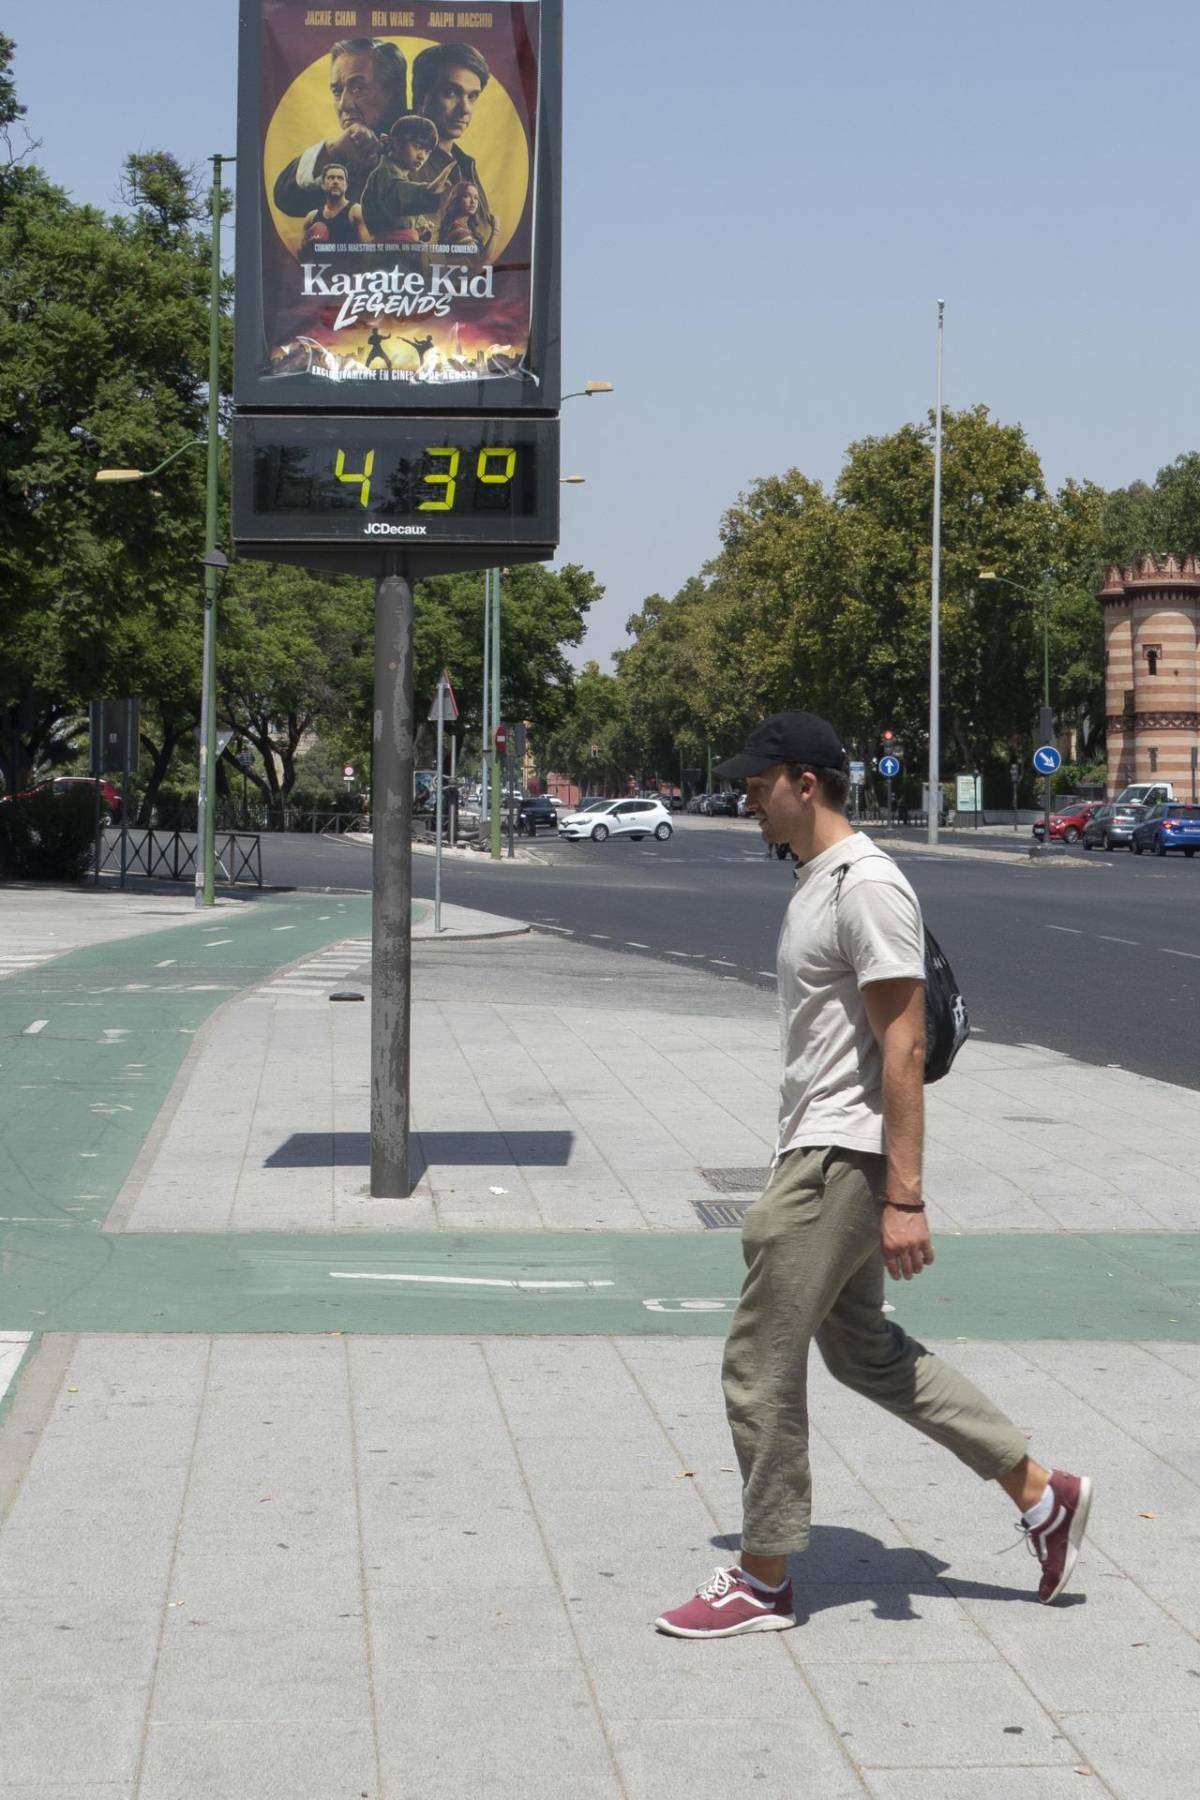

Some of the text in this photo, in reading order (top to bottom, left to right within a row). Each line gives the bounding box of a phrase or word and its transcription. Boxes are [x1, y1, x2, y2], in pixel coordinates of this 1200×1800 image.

[304, 10, 356, 26] JACKIE CHAN
[371, 11, 415, 28] BEN WANG
[428, 12, 493, 29] RALPH MACCHIO
[300, 263, 495, 298] Karate Kid
[333, 293, 452, 331] LEGENDS
[364, 523, 427, 536] JCDecaux
